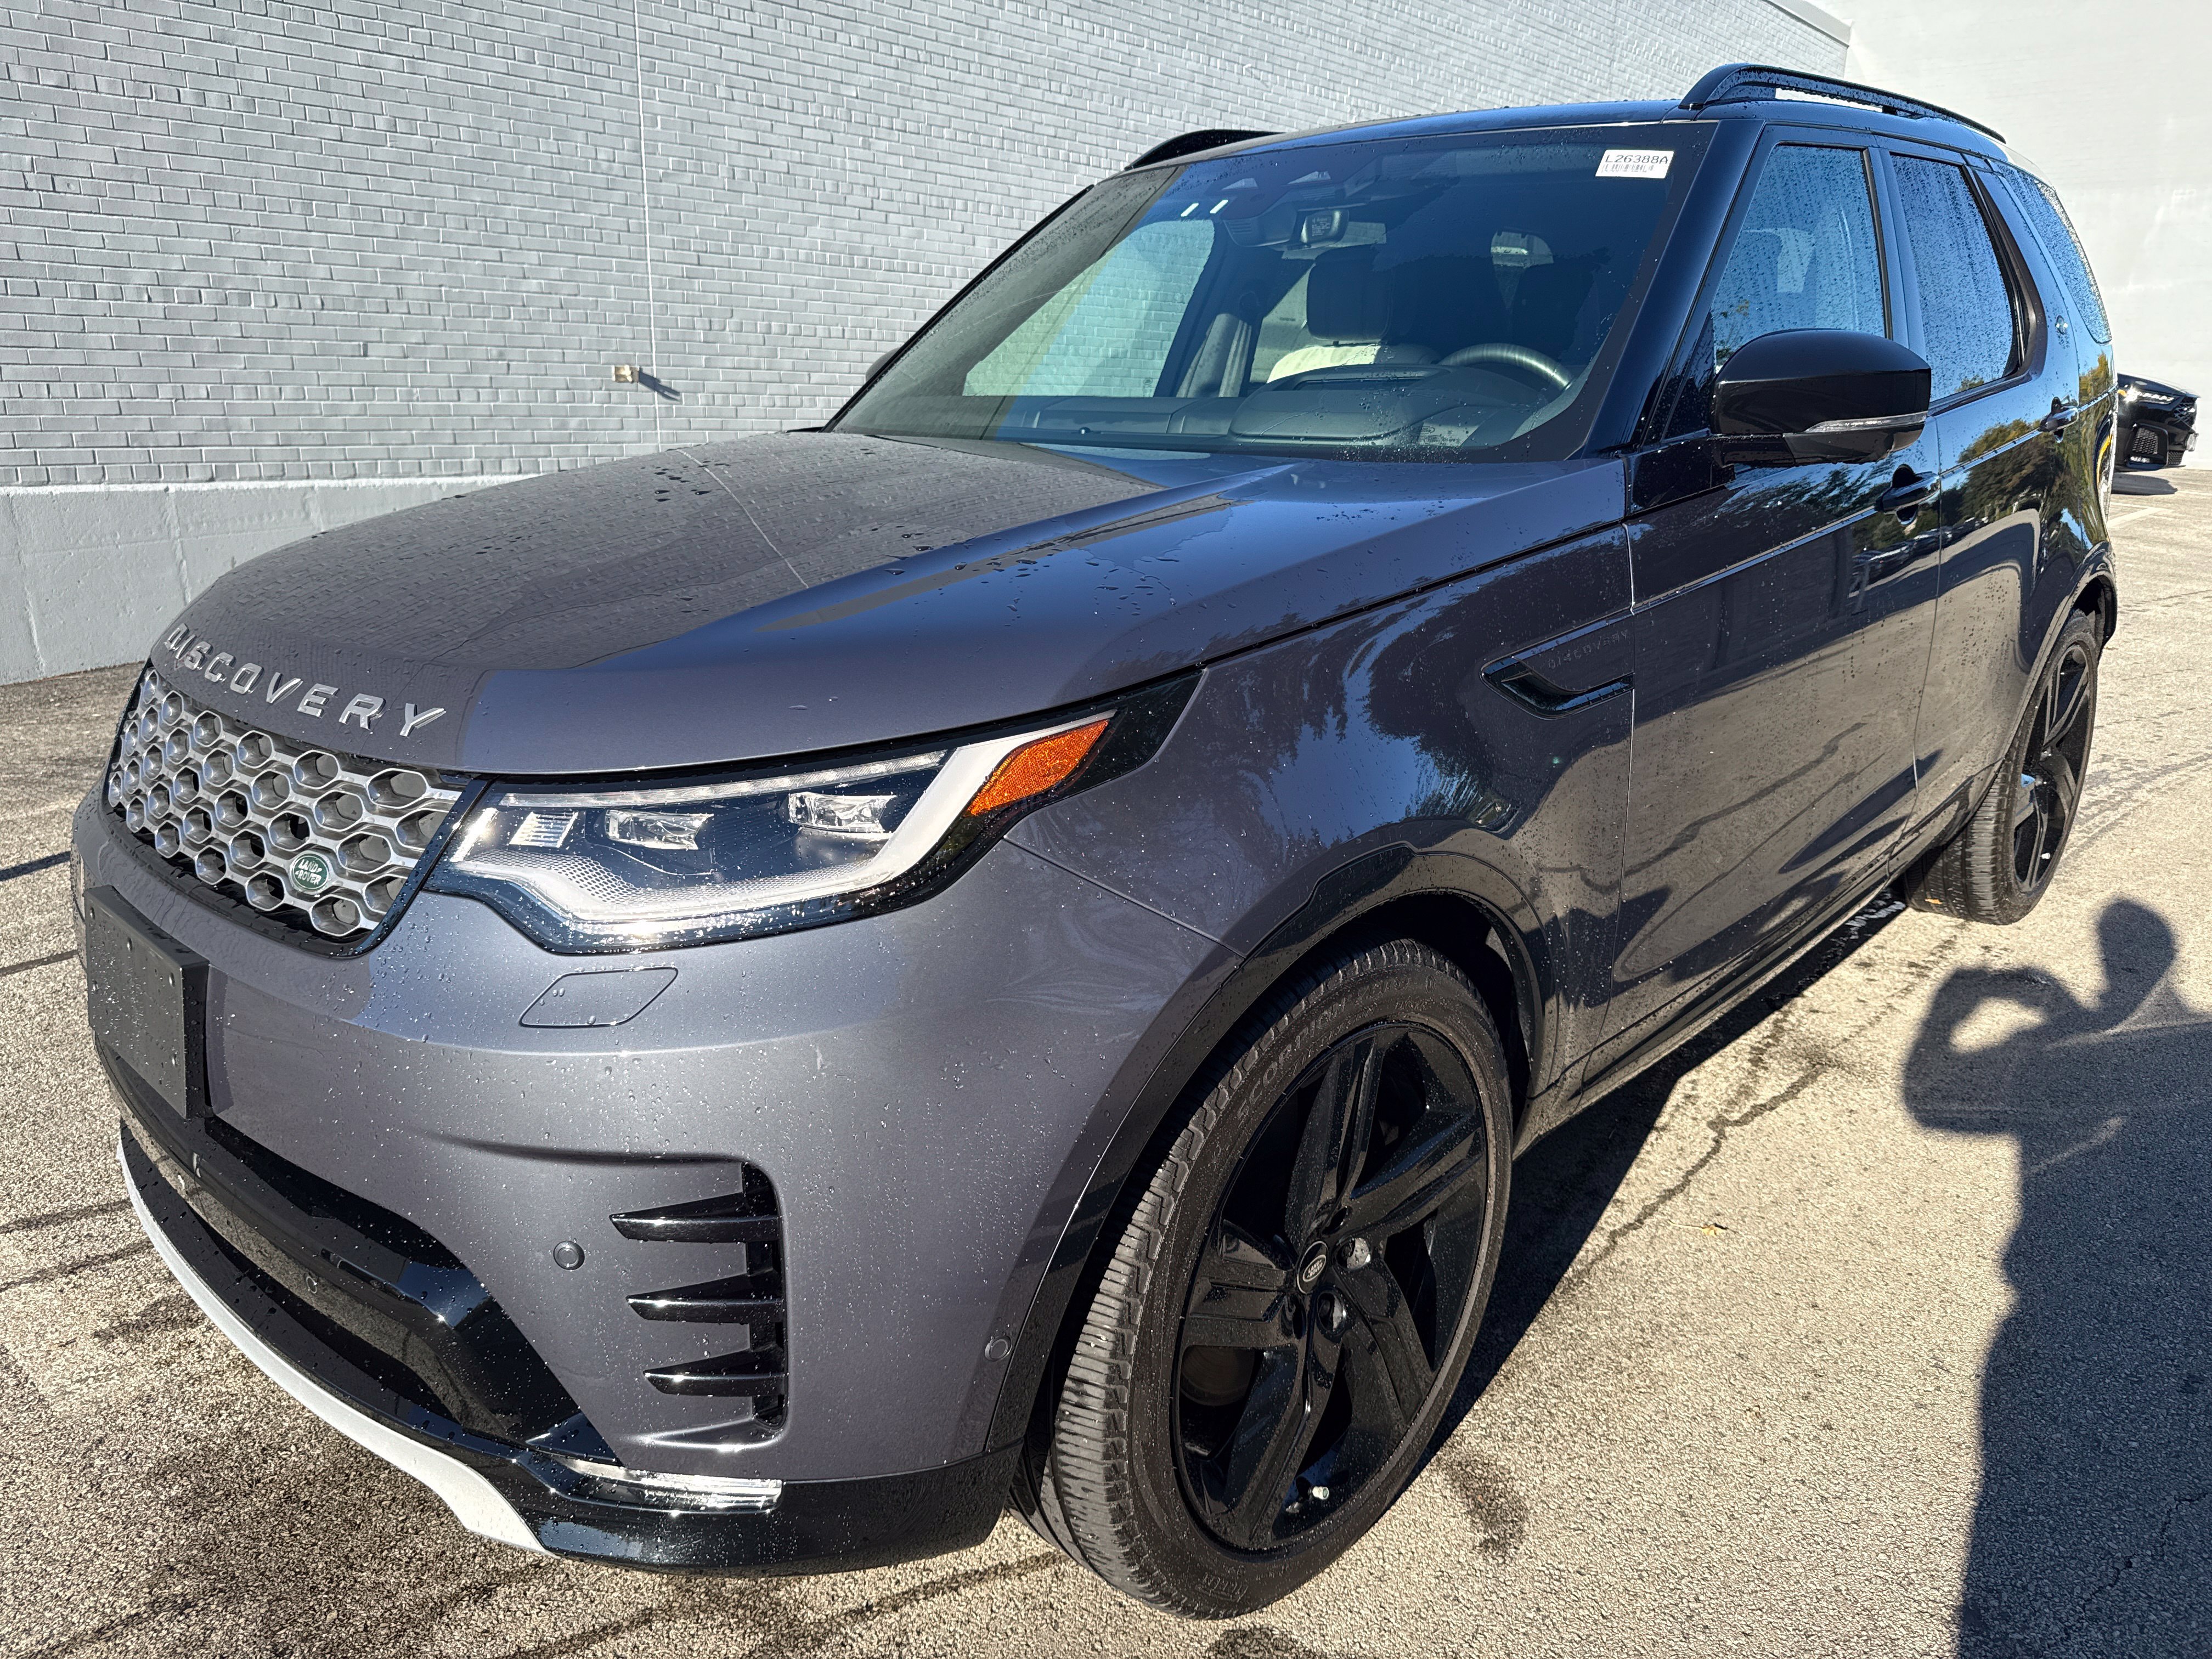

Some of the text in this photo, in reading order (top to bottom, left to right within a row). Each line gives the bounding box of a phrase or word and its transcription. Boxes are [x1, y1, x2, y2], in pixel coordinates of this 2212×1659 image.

[1605, 155, 1668, 164] L26388A
[166, 623, 446, 737] DISCOVERY
[298, 859, 319, 872] LAND
[297, 870, 322, 885] ROVER
